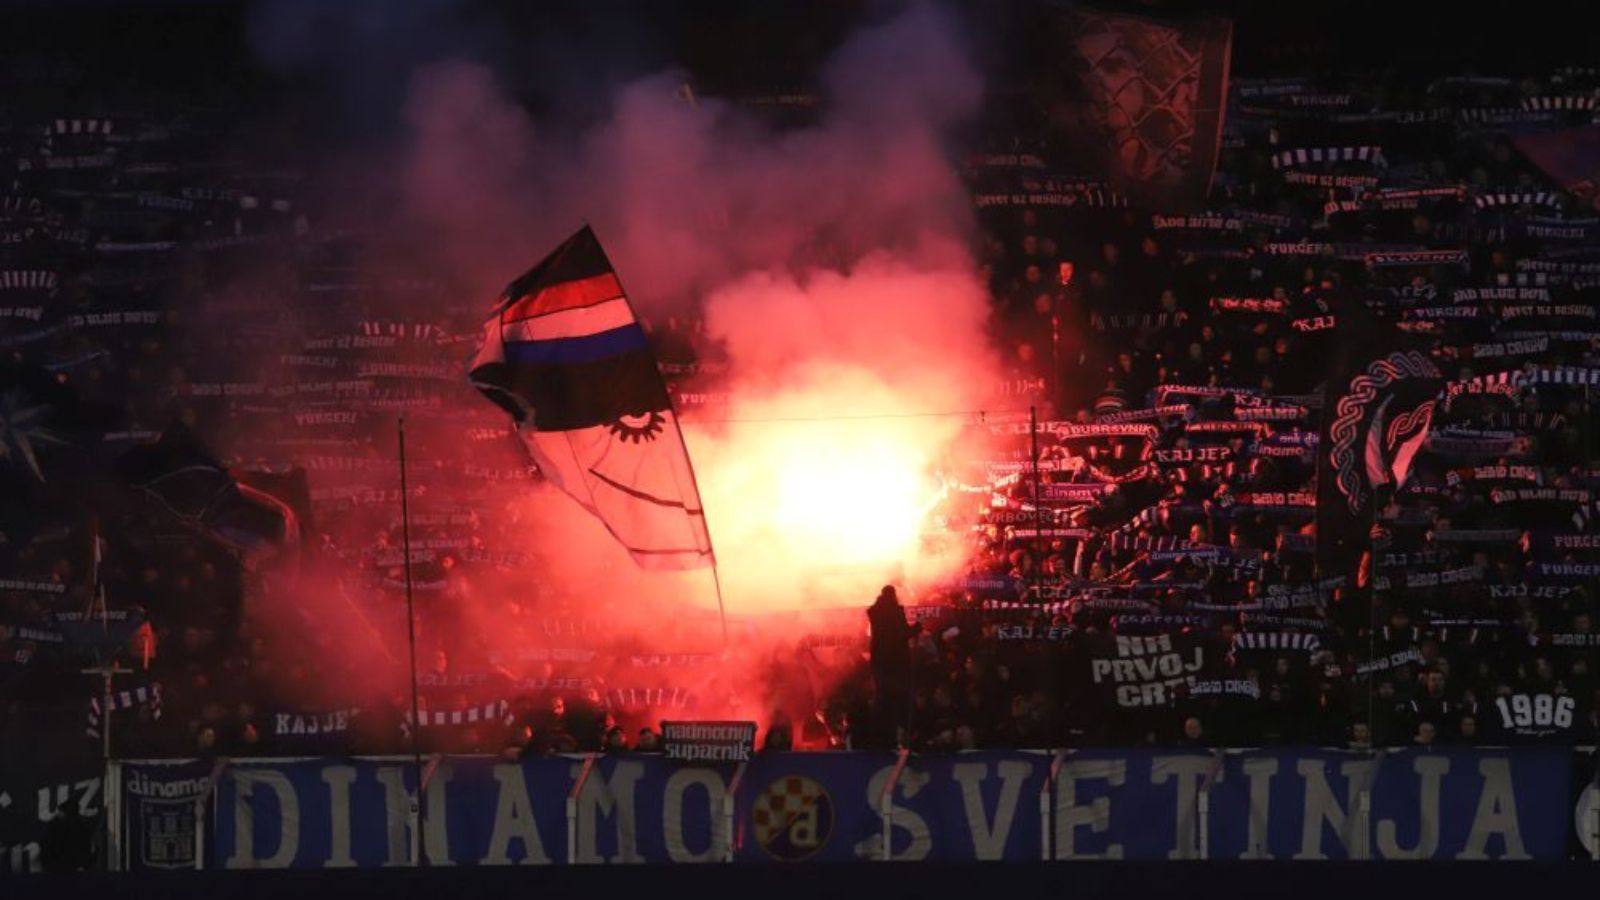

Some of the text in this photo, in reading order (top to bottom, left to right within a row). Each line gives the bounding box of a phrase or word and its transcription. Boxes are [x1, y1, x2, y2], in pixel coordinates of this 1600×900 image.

[1196, 446, 1231, 460] JE?
[1091, 647, 1203, 684] PRVOJ
[275, 712, 317, 735] KAJ
[1495, 693, 1575, 729] 1986
[225, 754, 1536, 870] DINAMO SVETINJA
